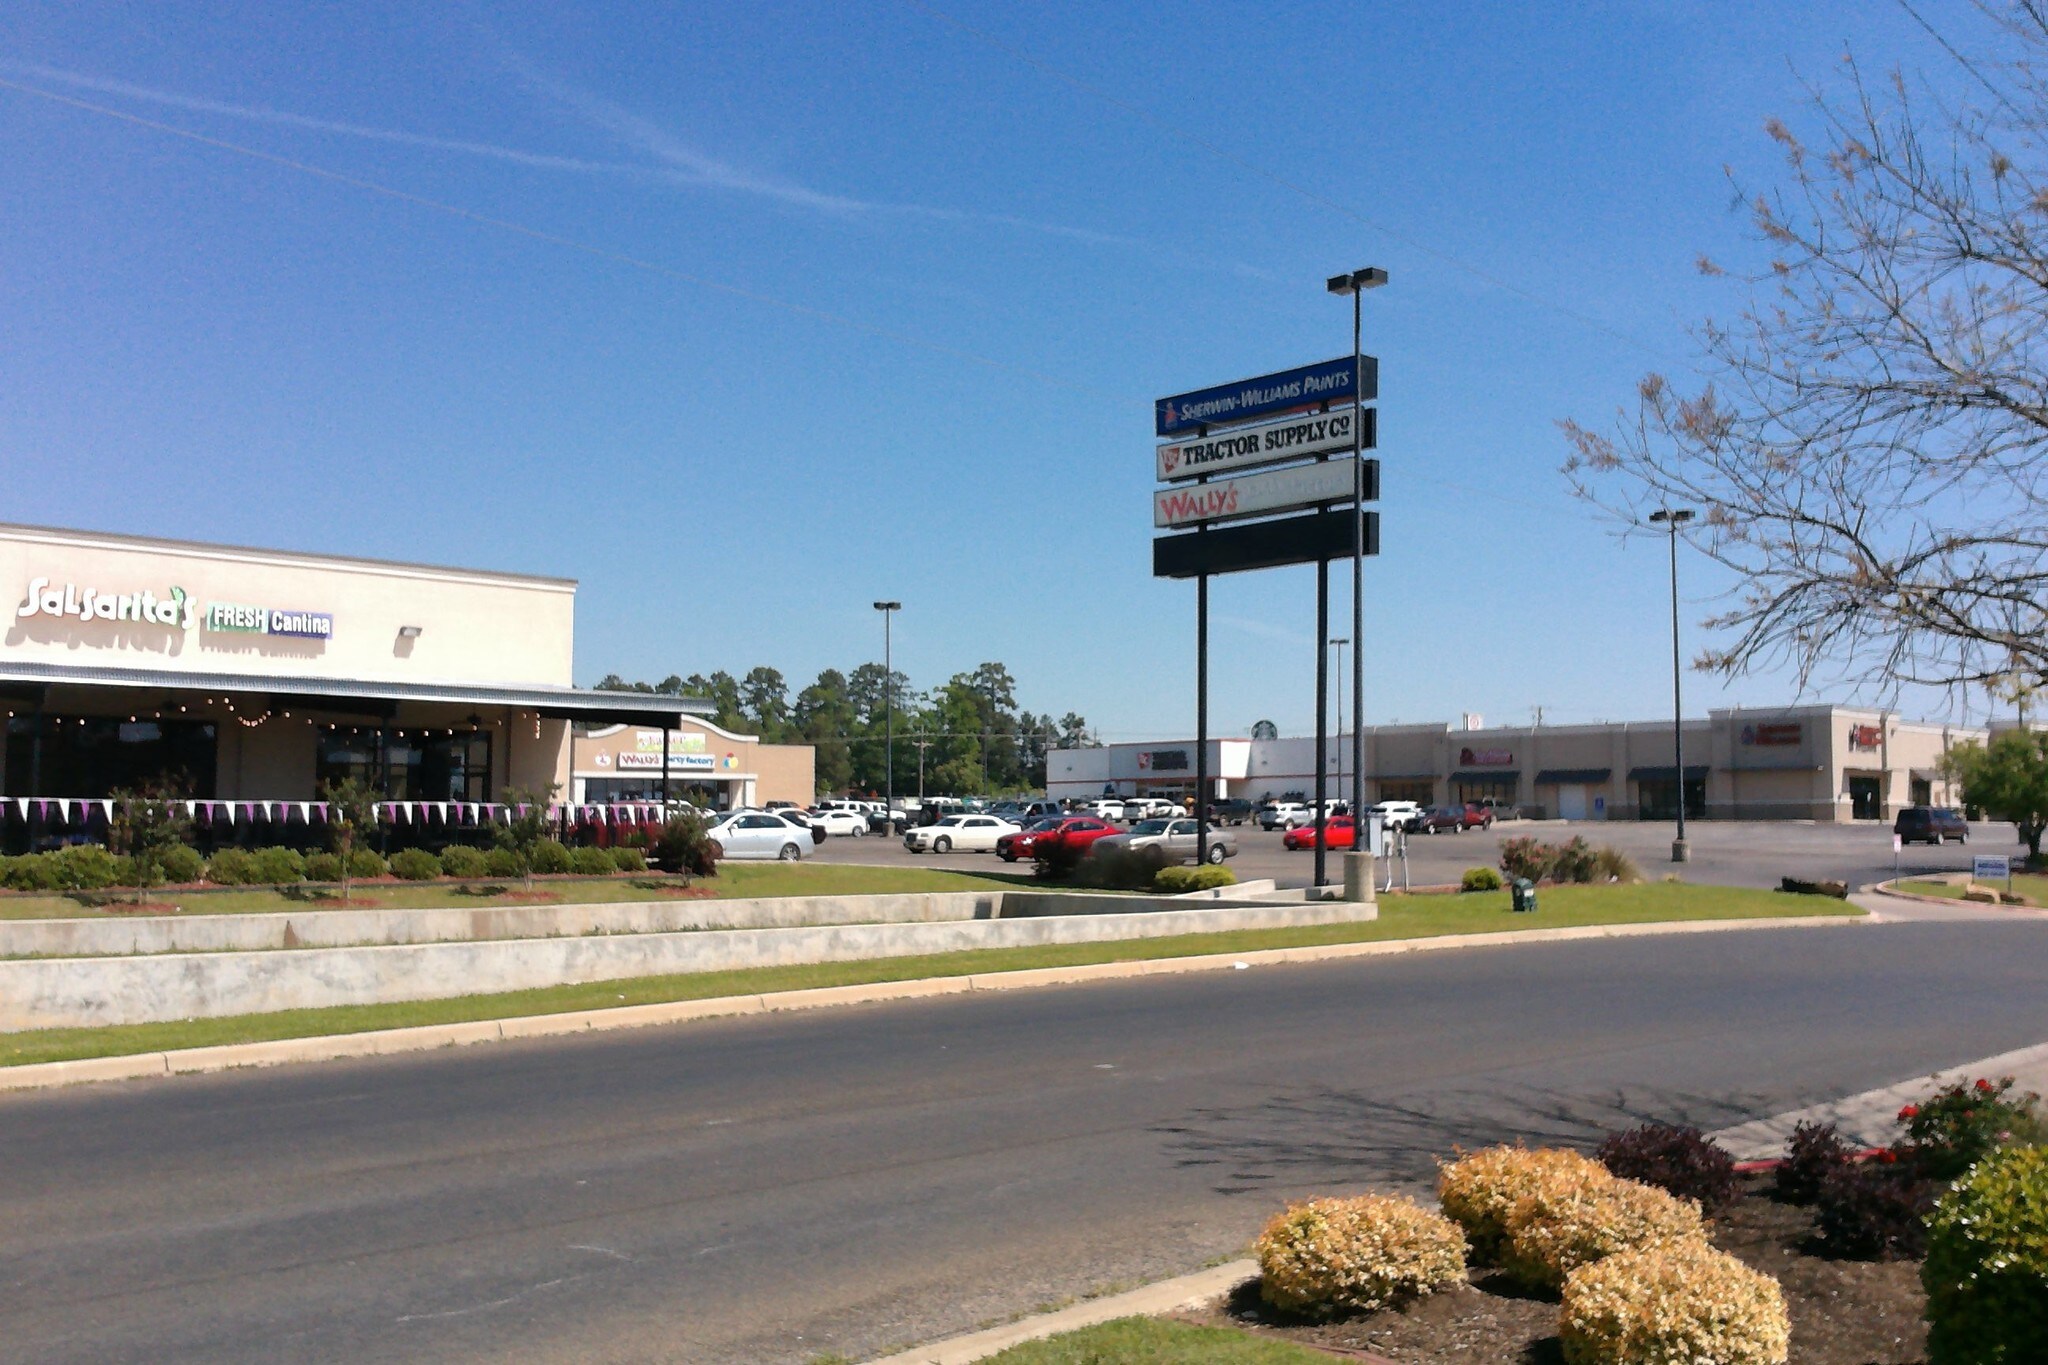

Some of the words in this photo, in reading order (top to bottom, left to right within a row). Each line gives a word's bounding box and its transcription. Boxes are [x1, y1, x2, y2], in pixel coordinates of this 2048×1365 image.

[1180, 382, 1301, 421] SHERWIN-WILLIAMS
[1304, 370, 1351, 395] PAINTS
[1183, 435, 1260, 465] TRACTOR
[1265, 420, 1328, 450] SUPPLY
[1160, 482, 1238, 522] WALLY'S
[18, 577, 197, 629] Salsarita's
[213, 604, 266, 629] FRESH
[271, 611, 331, 635] Cantina
[667, 756, 685, 765] arty
[686, 756, 714, 766] factory
